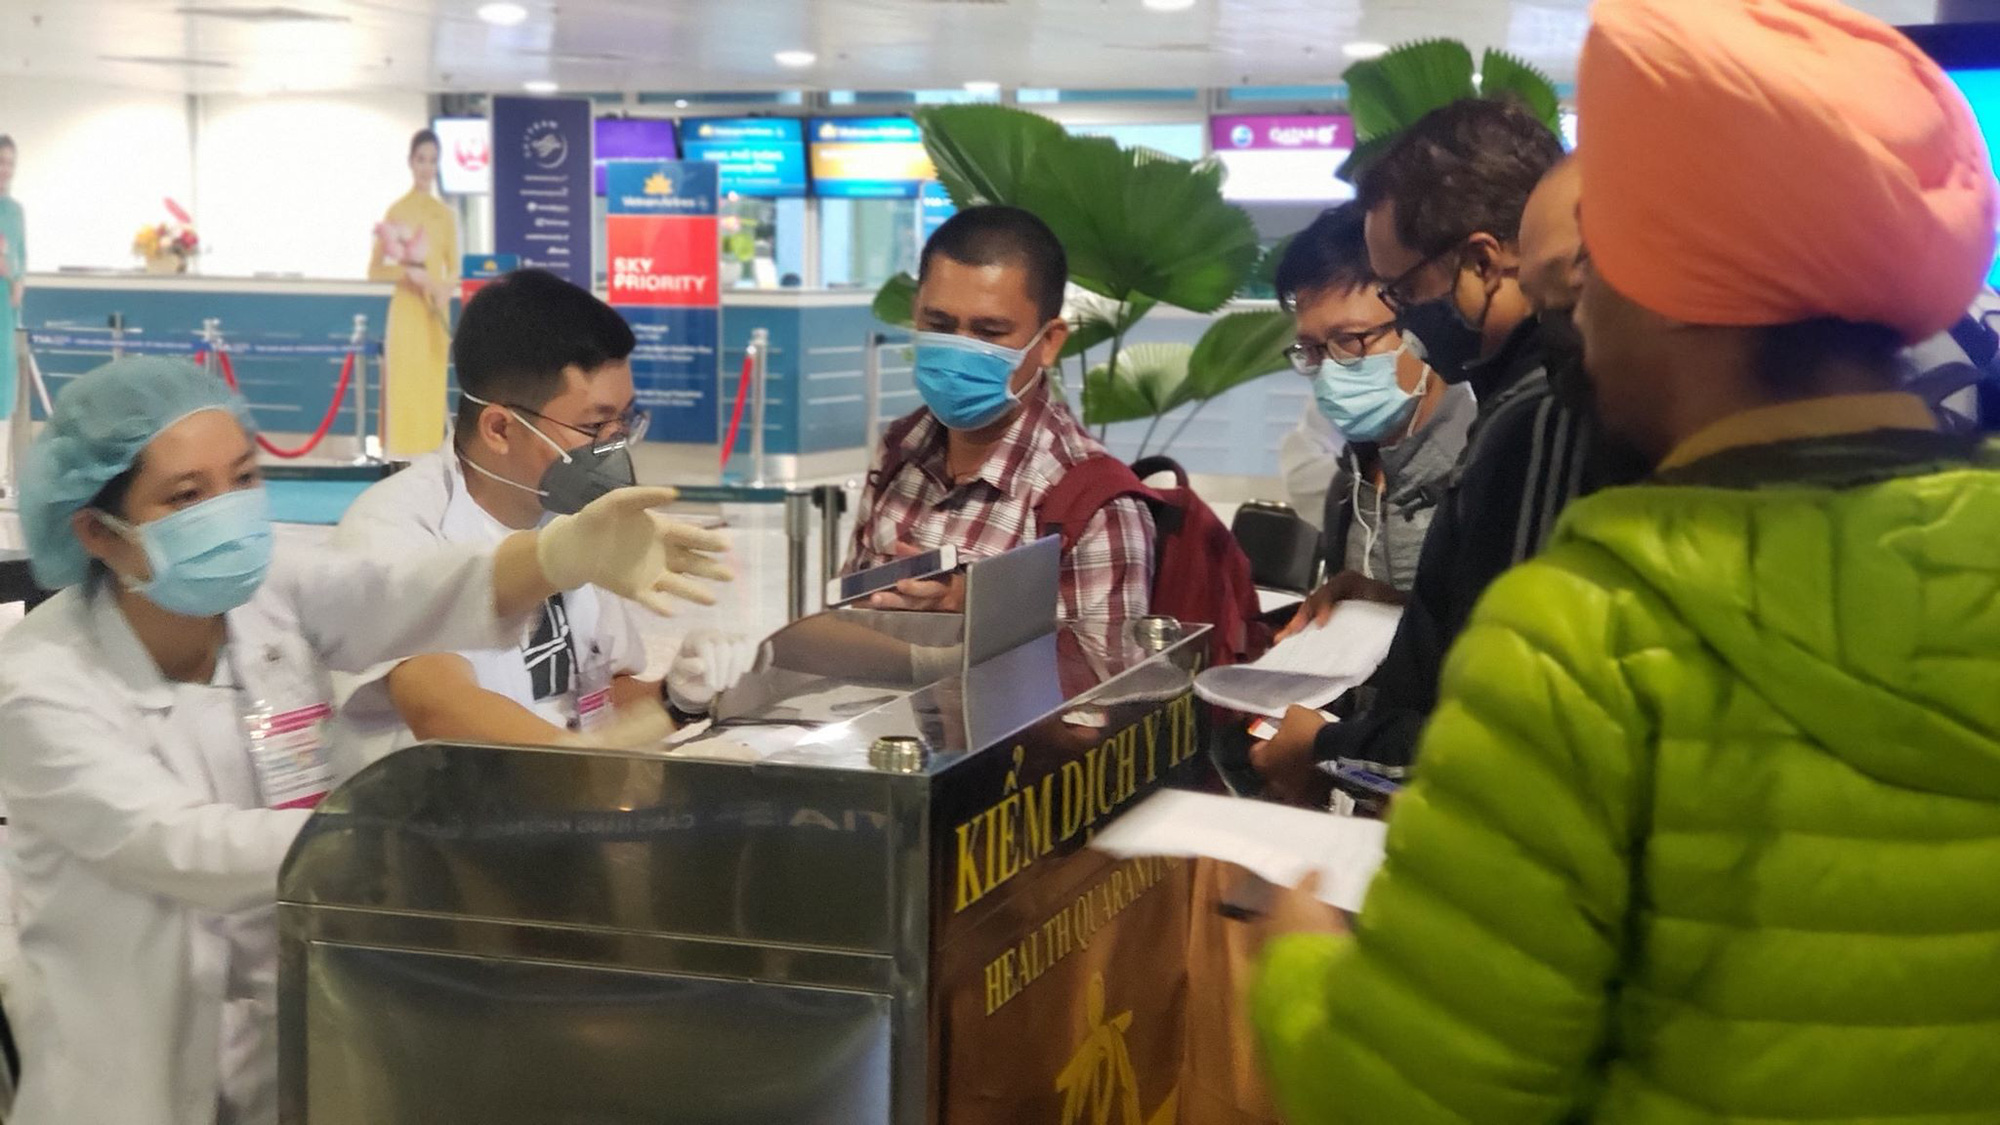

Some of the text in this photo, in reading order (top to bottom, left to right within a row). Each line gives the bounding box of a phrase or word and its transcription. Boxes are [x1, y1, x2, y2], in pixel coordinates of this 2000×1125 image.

[613, 257, 653, 273] SKY
[613, 273, 707, 292] PRIORITY
[953, 744, 1054, 912] KIỂM
[1059, 722, 1139, 848] DỊCH
[1142, 708, 1163, 783] Y
[984, 907, 1071, 1017] HEALTH
